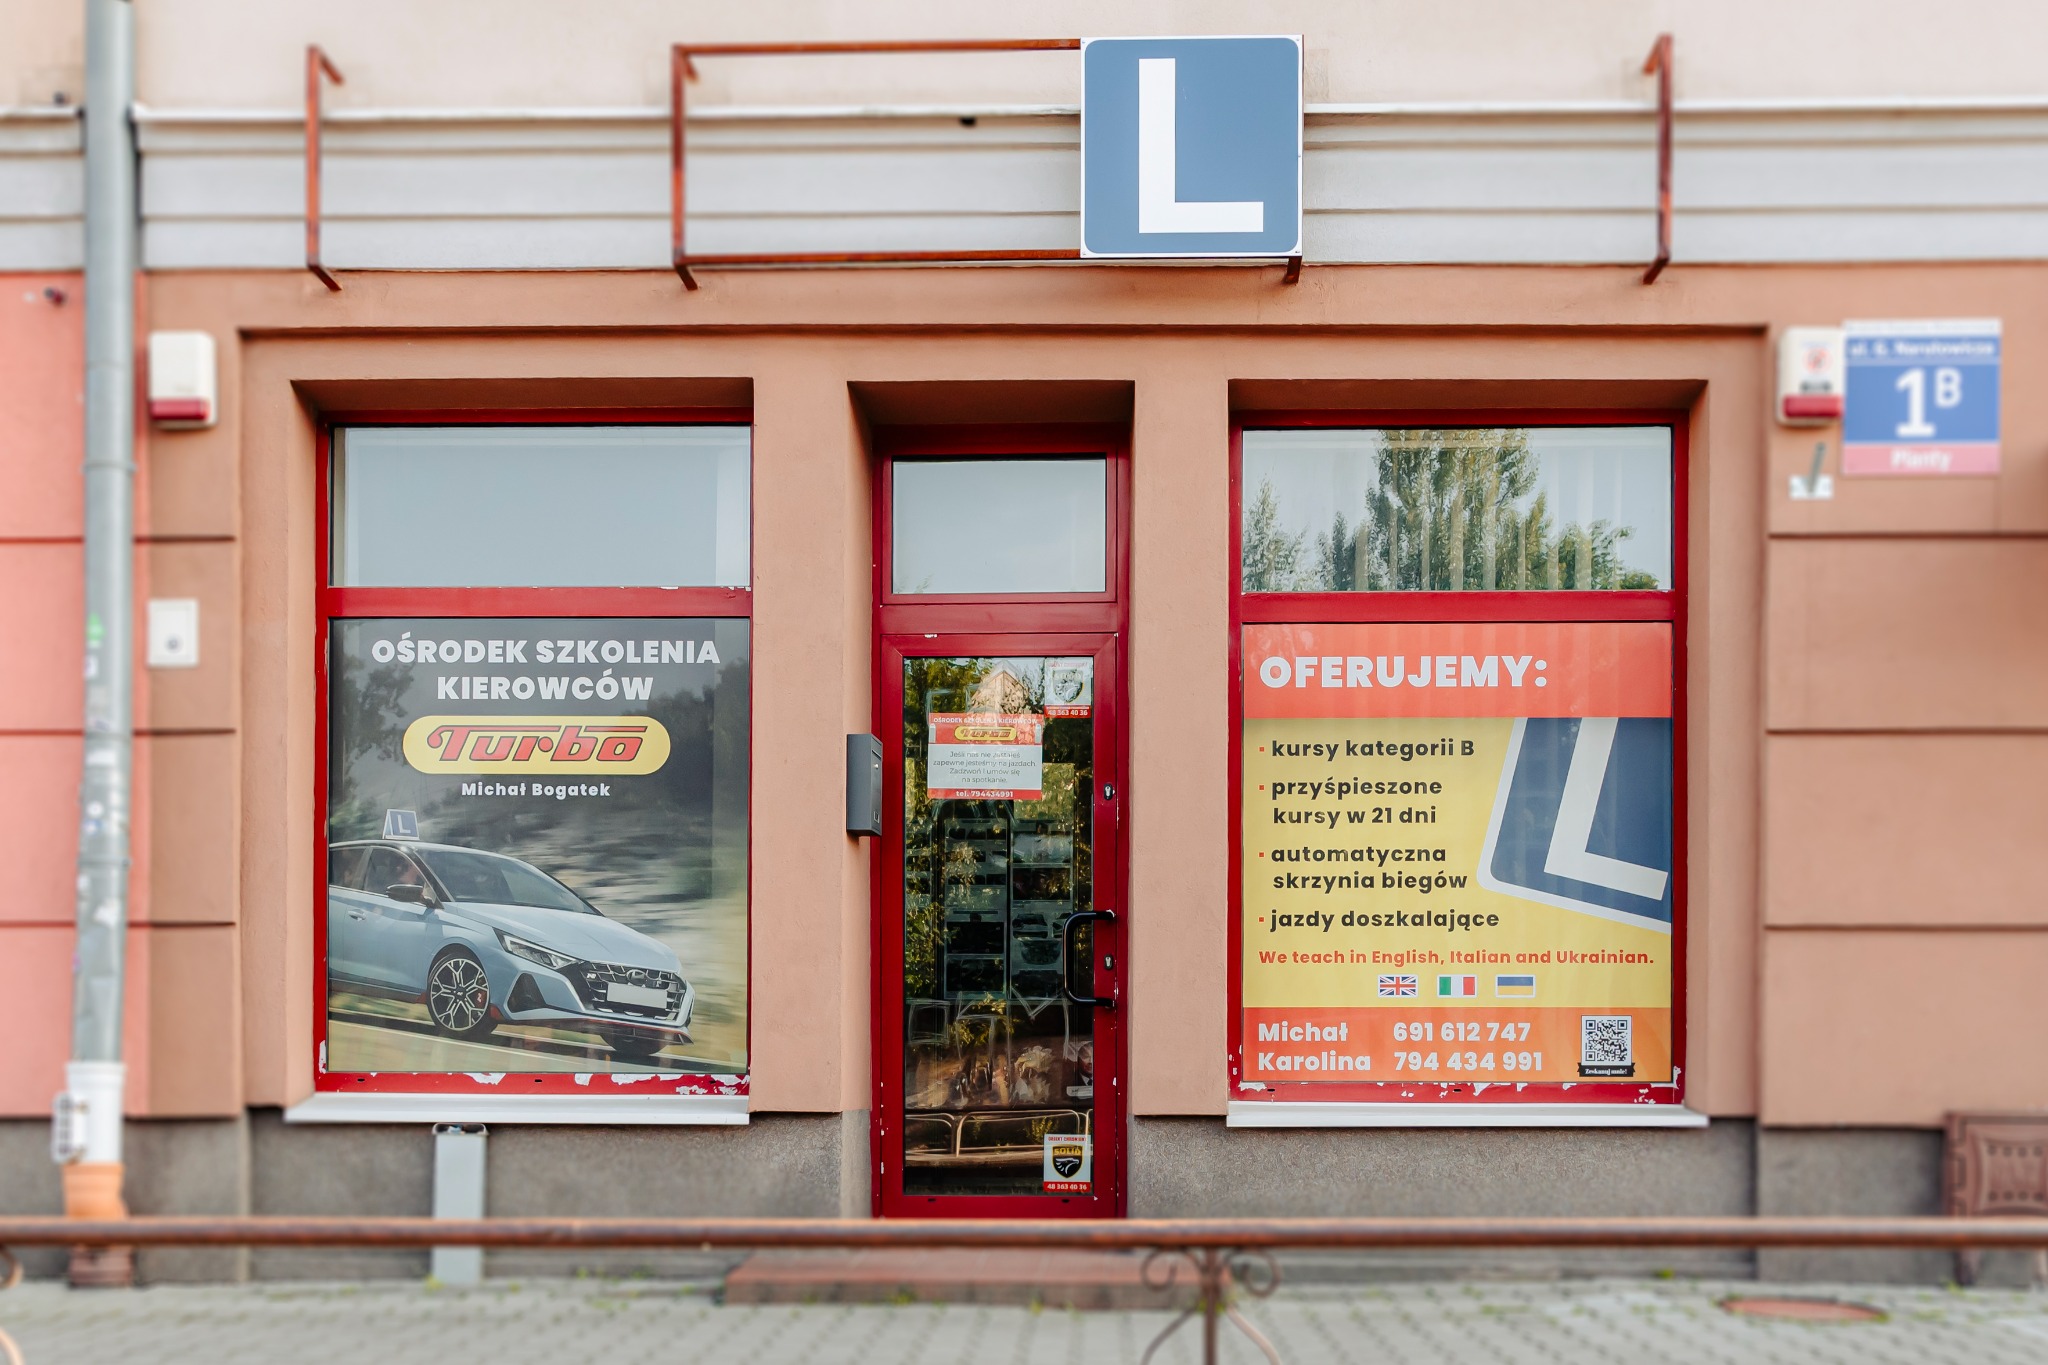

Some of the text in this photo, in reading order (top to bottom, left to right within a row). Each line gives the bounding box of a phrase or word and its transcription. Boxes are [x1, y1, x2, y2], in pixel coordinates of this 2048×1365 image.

[1138, 57, 1264, 233] L
[1891, 449, 1951, 472] Planty
[371, 631, 720, 664] OŚRODEK SZKOLENIA
[1260, 655, 1549, 688] OFERUJEMY:
[437, 668, 653, 701] KIEROWCÓW
[427, 724, 647, 762] Turbo
[1272, 739, 1475, 762] kursy kategorii B
[462, 782, 611, 800] Michał Bogatek
[971, 790, 1013, 798] 794434991
[1272, 778, 1443, 800] przyśpieszone
[397, 814, 411, 834] L
[1273, 807, 1436, 830] kursy w 21 dni
[1271, 846, 1446, 868] automatyczna
[1273, 870, 1468, 895] skrzynia biegów
[1270, 909, 1500, 932] jazdy doszkalające
[1258, 950, 1655, 968] We teach in English, Italian and Ukrainian.
[1258, 1022, 1531, 1042] Michał 691 612 747
[1258, 1051, 1542, 1071] Karolina 794 434 991
